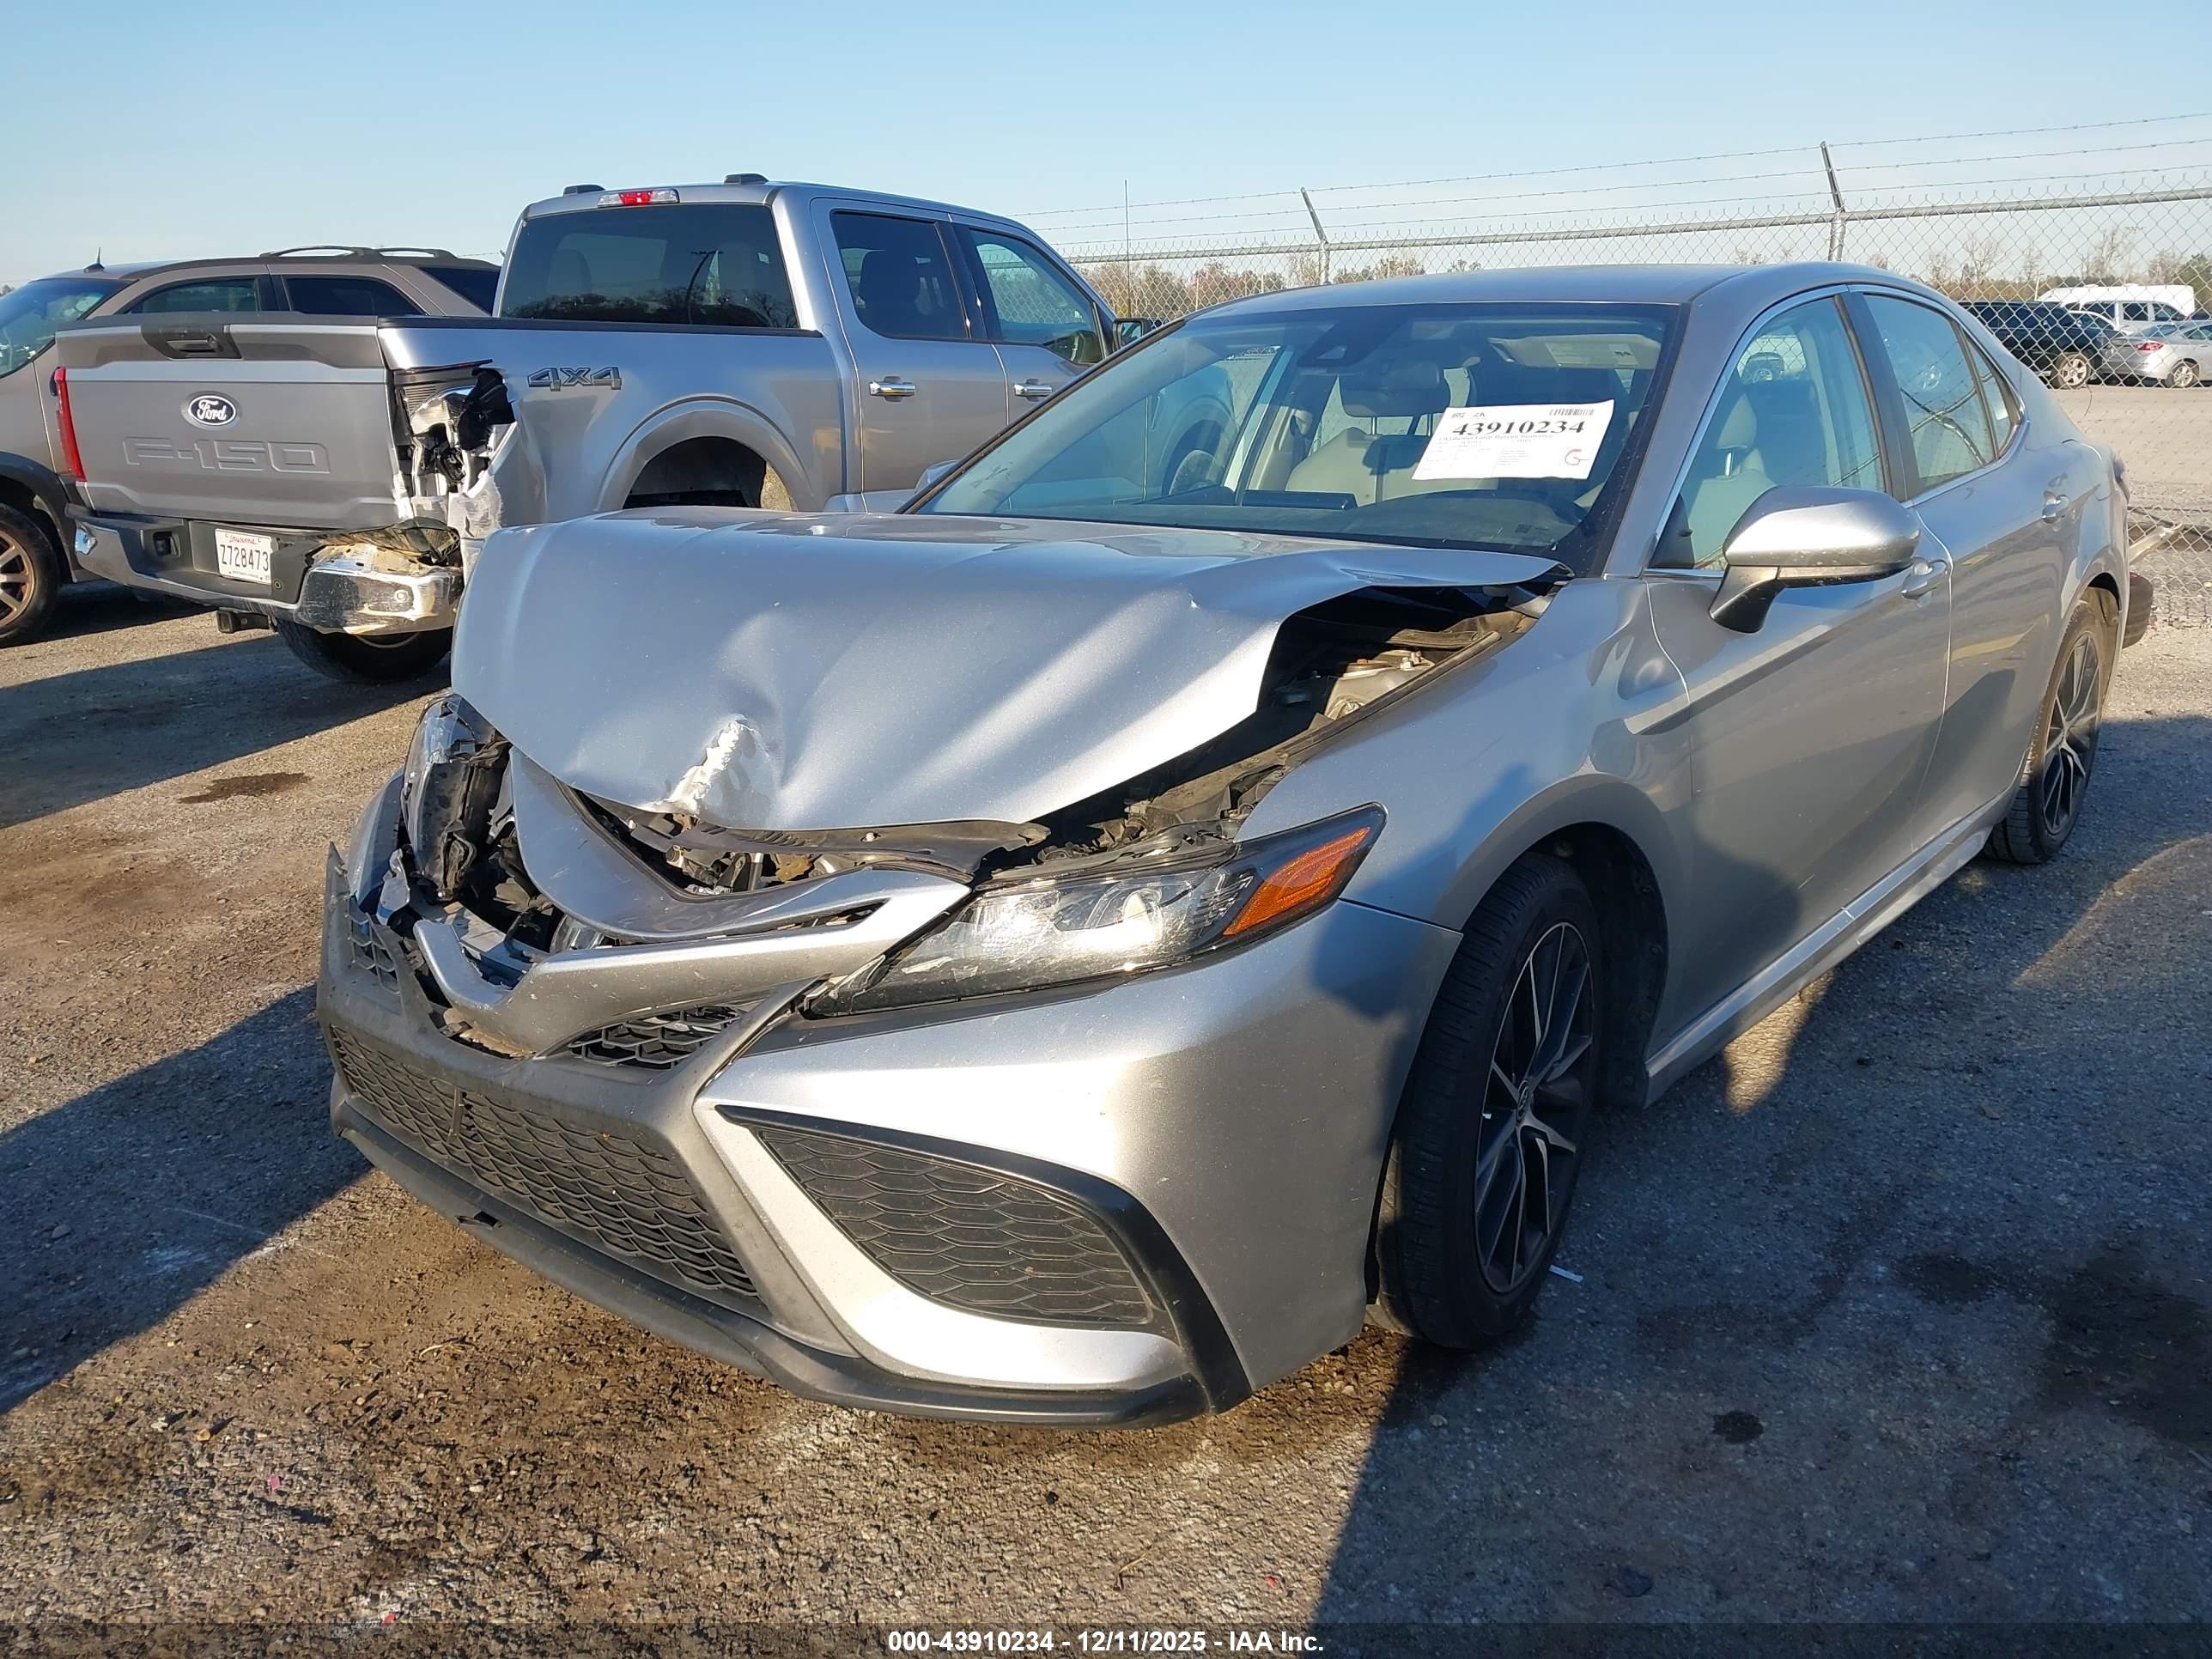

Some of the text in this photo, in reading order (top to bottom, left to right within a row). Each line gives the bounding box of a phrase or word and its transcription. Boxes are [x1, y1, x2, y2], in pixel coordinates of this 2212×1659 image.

[197, 399, 228, 421] Ford
[1452, 420, 1586, 435] 43910234
[122, 435, 331, 474] F-150
[219, 544, 270, 572] Z728473
